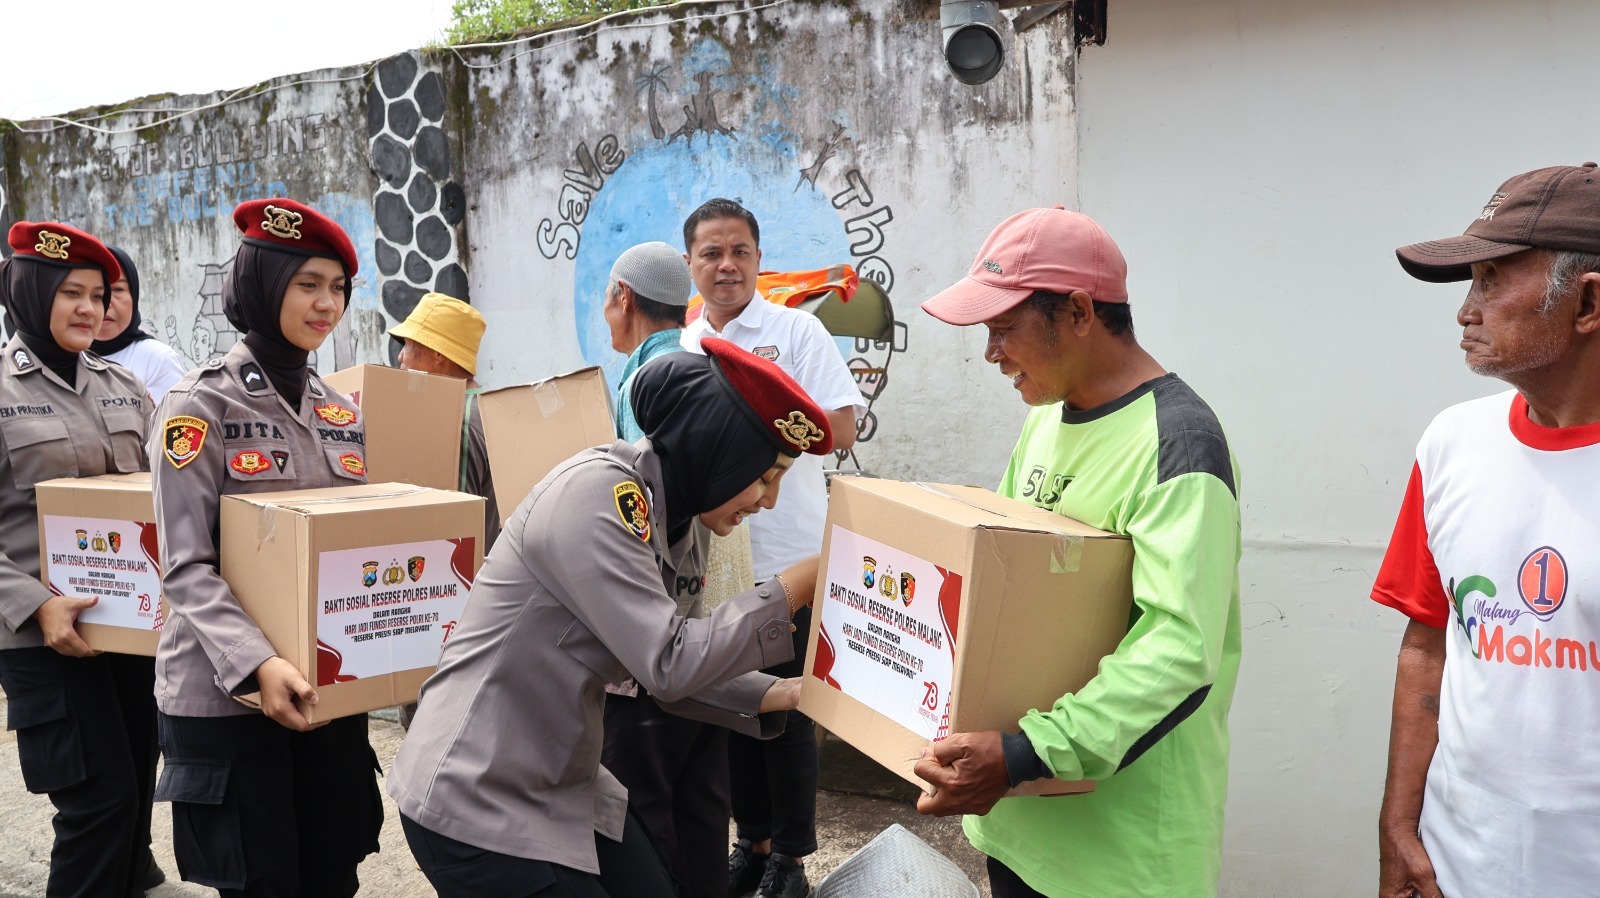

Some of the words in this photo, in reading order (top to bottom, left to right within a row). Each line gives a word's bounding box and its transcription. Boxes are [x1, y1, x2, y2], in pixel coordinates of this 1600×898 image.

[99, 141, 158, 181] STOP
[179, 113, 326, 170] BULLYING
[135, 162, 256, 200] DEFEND
[537, 133, 625, 260] Save
[102, 200, 154, 230] THE
[17, 404, 55, 416] PRASTIKA
[101, 397, 142, 410] POLRI
[223, 422, 285, 440] DITA
[317, 428, 365, 446] POLRI
[52, 553, 67, 566] BAKTI
[67, 554, 86, 567] SOSIAL
[86, 556, 108, 569] RESERSE
[108, 558, 127, 571] POLRES
[127, 560, 148, 574] MALANG
[1533, 552, 1554, 606] 1
[324, 598, 344, 615] BAKTI
[346, 594, 370, 611] SOSIAL
[371, 589, 401, 607] RESERSE
[402, 586, 428, 603] POLRES
[429, 583, 457, 599] MALANG
[373, 609, 390, 619] DALAM
[391, 607, 411, 616] RANGKA
[1474, 598, 1522, 626] Malang
[344, 624, 356, 635] HARI
[357, 622, 369, 633] JADI
[369, 618, 387, 631] FUNGSI
[387, 616, 409, 629] RESERSE
[409, 613, 424, 625] POLRI
[424, 612, 439, 623] KE-78
[829, 582, 847, 604] BAKTI
[847, 589, 867, 613] SOSIAL
[868, 598, 894, 626] RESERSE
[894, 610, 917, 637] POLRES
[917, 621, 942, 650] MALANG
[374, 630, 391, 640] PRESISI
[392, 627, 404, 637] SIAP
[922, 681, 938, 711] 78
